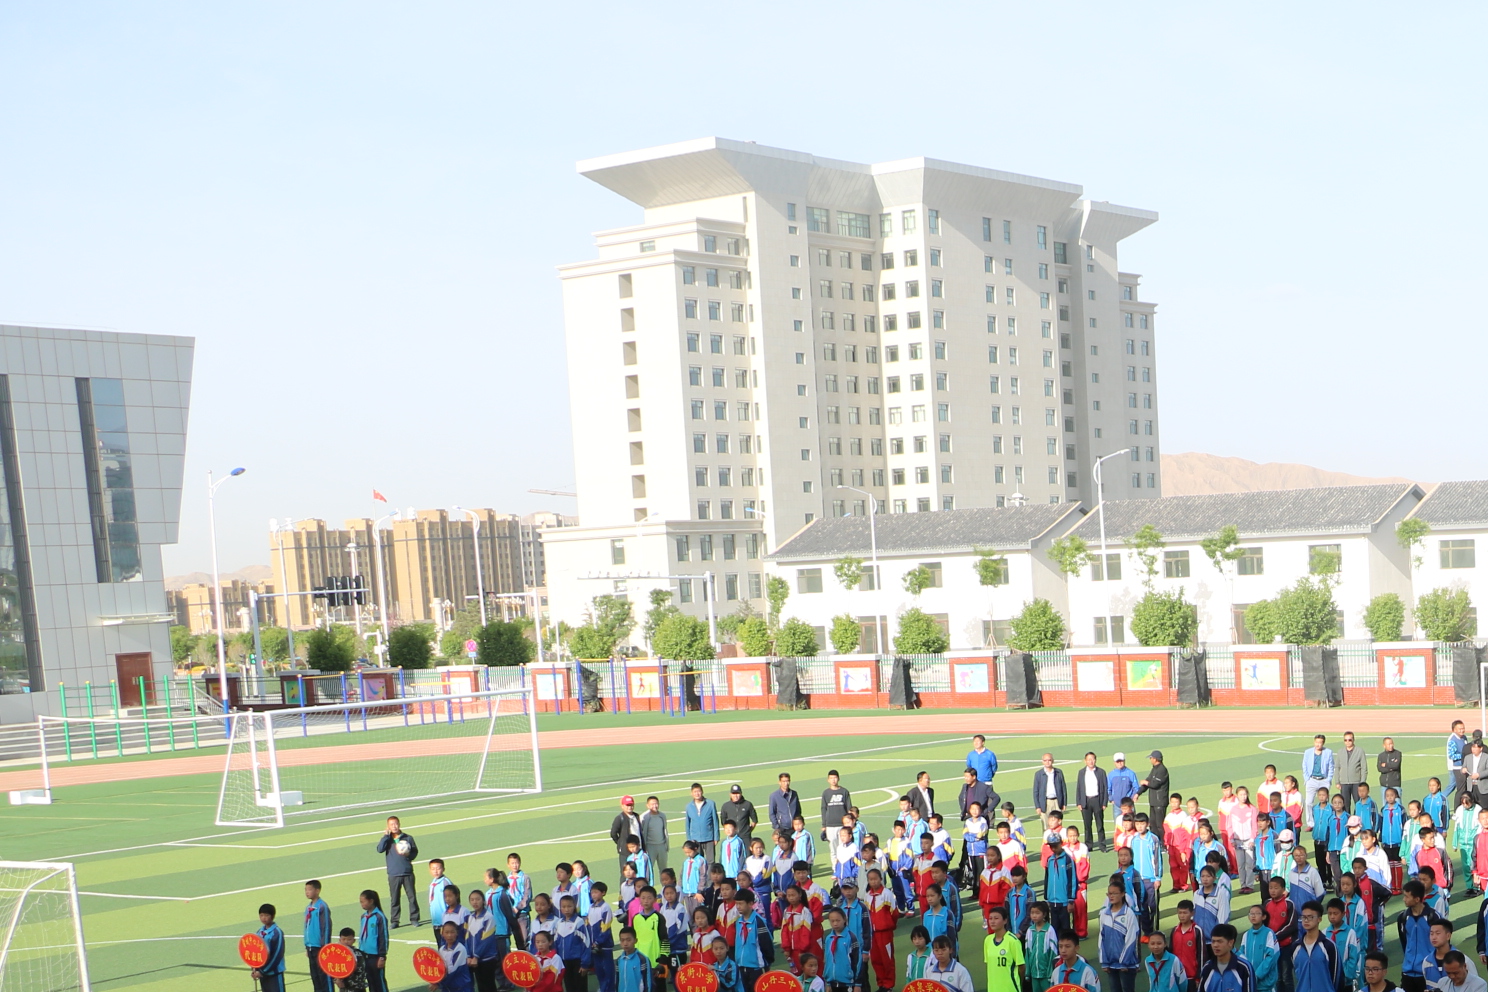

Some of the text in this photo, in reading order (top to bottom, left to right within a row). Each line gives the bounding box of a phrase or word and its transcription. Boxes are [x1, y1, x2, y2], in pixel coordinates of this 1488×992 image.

[506, 955, 536, 970] 三立小学
[997, 957, 1007, 967] 10
[327, 963, 347, 972] 代表队
[420, 965, 440, 977] 代表队
[512, 971, 534, 981] 代表队
